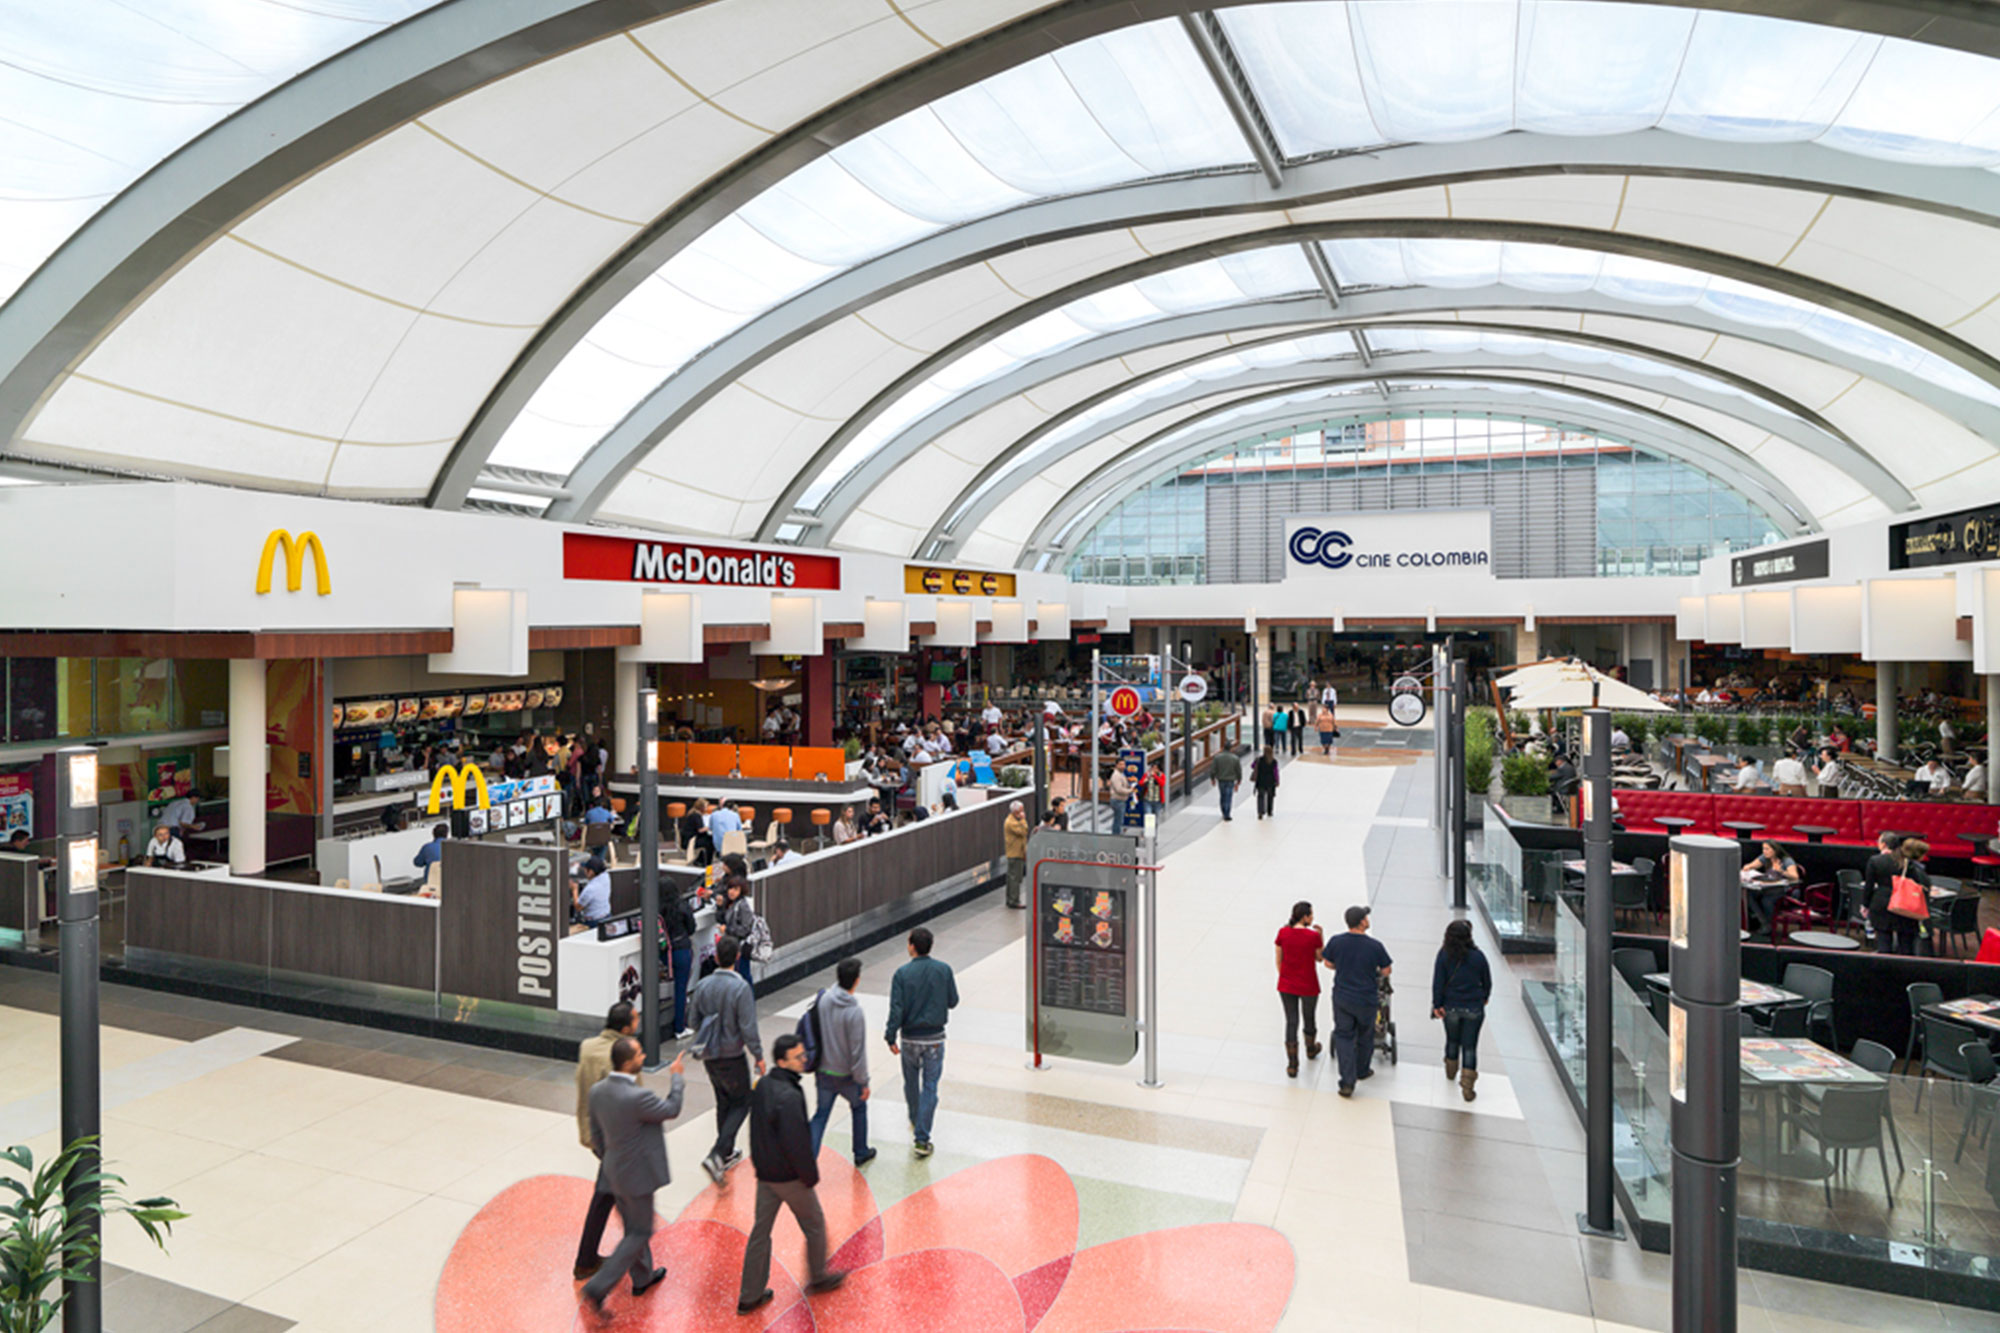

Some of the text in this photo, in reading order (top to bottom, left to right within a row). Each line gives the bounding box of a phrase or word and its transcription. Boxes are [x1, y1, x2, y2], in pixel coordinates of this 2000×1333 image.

[633, 542, 796, 586] McDonald's
[1356, 550, 1489, 568] CINE COLOMBIA
[1046, 847, 1132, 865] DIRECTORIO
[517, 856, 552, 998] POSTRES
